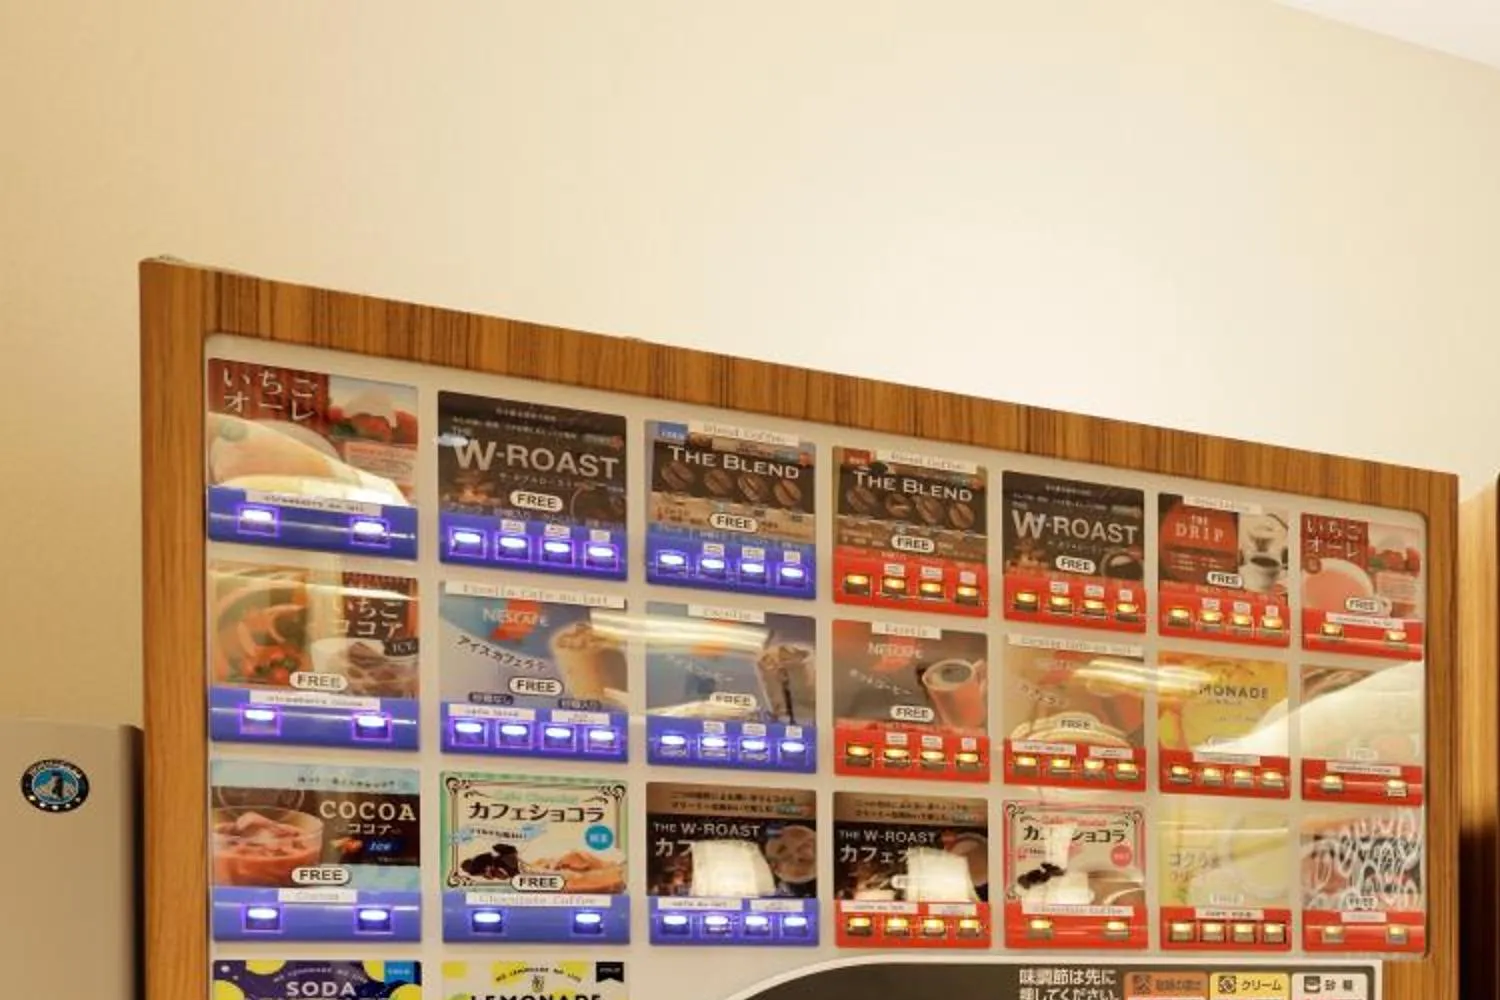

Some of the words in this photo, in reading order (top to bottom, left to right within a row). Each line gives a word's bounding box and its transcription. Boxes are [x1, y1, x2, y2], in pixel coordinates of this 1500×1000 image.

[223, 368, 318, 398] いちご
[223, 392, 316, 421] オーレ
[453, 438, 619, 480] W-ROAST
[668, 446, 715, 467] THE
[723, 456, 801, 481] BLEND
[853, 469, 895, 491] THE
[902, 479, 974, 502] BLEND
[517, 493, 557, 508] FREE
[717, 515, 753, 529] FREE
[1011, 509, 1139, 545] W-ROAST
[1175, 522, 1225, 543] DRIP
[897, 537, 930, 550] FREE
[1307, 538, 1358, 558] オーレ
[1062, 557, 1091, 571] FREE
[1211, 572, 1240, 586] FREE
[1349, 598, 1377, 612] FREE
[297, 674, 342, 688] FREE
[516, 679, 557, 693] FREE
[1198, 683, 1269, 700] MONADE
[716, 695, 751, 708] FREE
[895, 706, 930, 719] FREE
[319, 800, 416, 821] COCOA
[468, 801, 605, 823] カフェショコラ
[654, 822, 677, 834] THE
[680, 823, 761, 839] W-ROAST
[839, 829, 860, 840] THE
[863, 829, 937, 844] W-ROAST
[1023, 824, 1127, 844] カショコラ
[299, 869, 343, 881] FREE
[519, 877, 558, 889] FREE
[1019, 969, 1117, 986] 味調節は先に
[1241, 979, 1283, 992] クリーム
[286, 981, 357, 997] SODA
